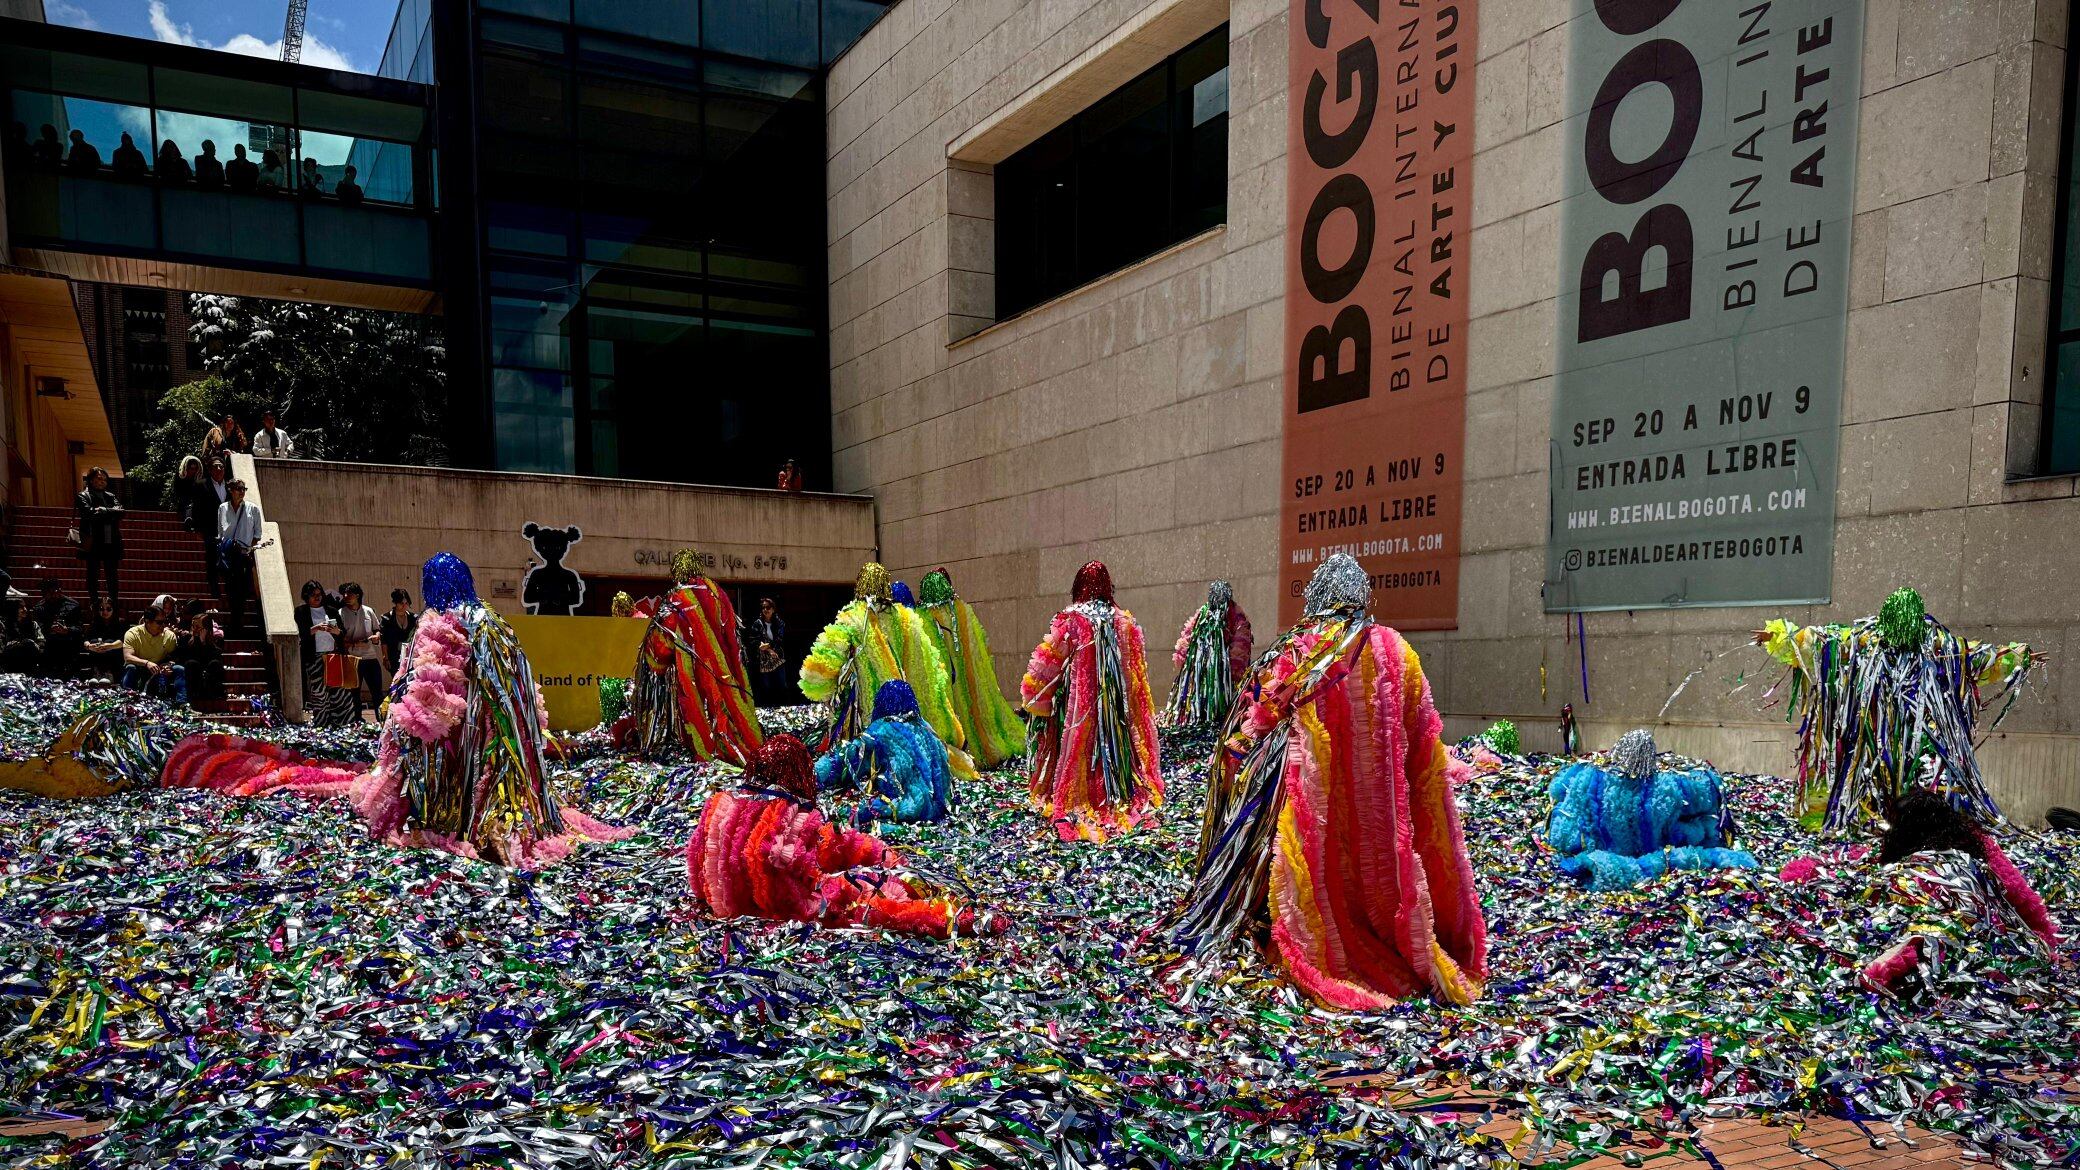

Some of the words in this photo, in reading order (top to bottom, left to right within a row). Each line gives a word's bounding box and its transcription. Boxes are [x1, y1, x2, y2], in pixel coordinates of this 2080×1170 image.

[1434, 0, 1459, 95] CIU
[1394, 0, 1420, 200] INTERN
[1790, 16, 1833, 188] ARTE
[1433, 120, 1456, 152] Y
[1577, 0, 1703, 344] BO
[1724, 90, 1767, 311] BIENAL
[1430, 166, 1455, 299] ARTE
[1784, 219, 1822, 298] DE
[1390, 220, 1415, 393] BIENAL
[1427, 323, 1450, 384] DE
[1573, 417, 1615, 447] SEP
[1634, 409, 1664, 438] 20
[1683, 404, 1698, 431] A
[1719, 391, 1773, 425] NOV
[1795, 385, 1811, 414] 9
[1295, 475, 1323, 498] SEP
[1335, 469, 1354, 492] 20
[1366, 465, 1375, 487] A
[1388, 457, 1422, 482] NOV
[1434, 452, 1445, 476] 9
[1577, 453, 1687, 490] ENTRADA
[1706, 438, 1797, 475] LIBRE
[1298, 504, 1368, 533] ENTRADA
[1380, 495, 1437, 523] LIBRE
[1567, 488, 1807, 530] WWW.BIENALBOGOTA.COM
[753, 555, 787, 570] 5-75
[1586, 535, 1804, 567] BIENALDEARTEBOGOTA
[539, 673, 573, 687] land
[577, 673, 593, 687] of
